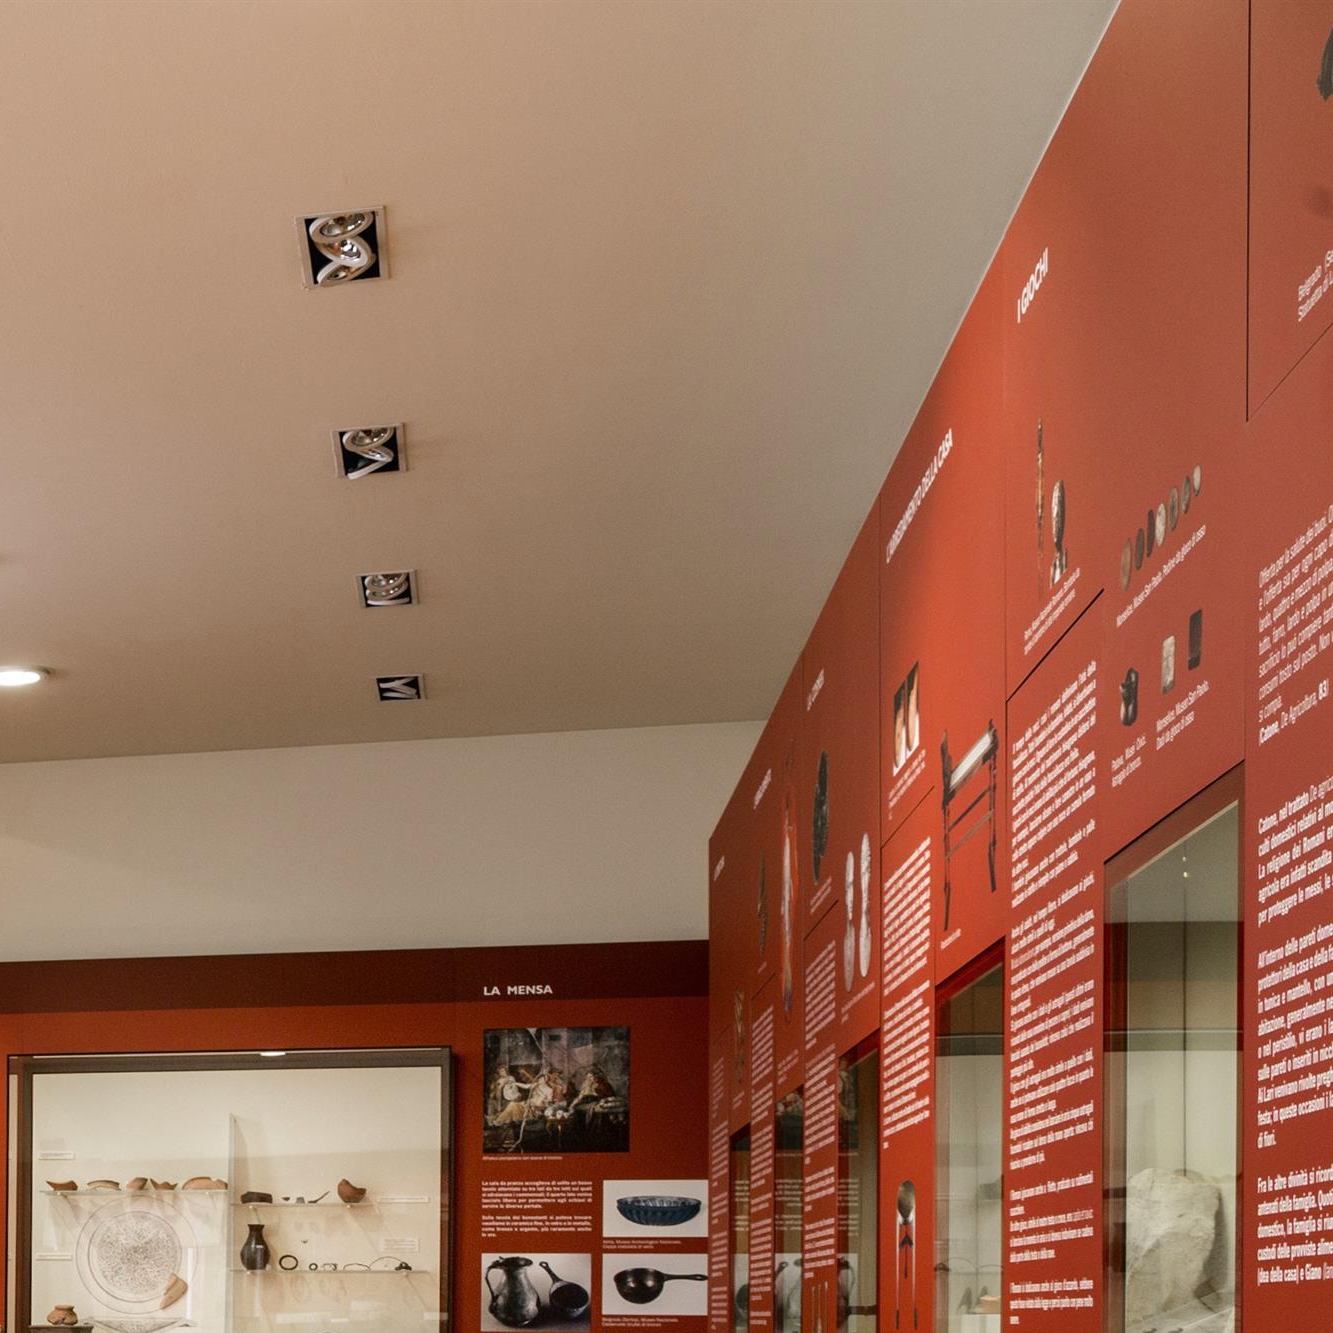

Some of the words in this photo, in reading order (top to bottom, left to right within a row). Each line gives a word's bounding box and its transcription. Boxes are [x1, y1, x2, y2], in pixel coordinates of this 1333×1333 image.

[1021, 247, 1049, 314] GIOCHI
[1258, 812, 1278, 834] Catone,
[1278, 801, 1288, 821] nel
[1287, 791, 1309, 816] trattato
[1309, 785, 1317, 802] De
[1258, 835, 1270, 857] culti
[1270, 819, 1296, 849] domestici
[1296, 807, 1317, 833] relativi
[1317, 803, 1324, 821] al
[1258, 863, 1265, 880] La
[1266, 850, 1290, 874] religione
[1291, 840, 1301, 860] dei
[1302, 827, 1325, 854] Romani
[1258, 877, 1279, 903] agricola
[1279, 874, 1290, 890] era
[1290, 860, 1307, 884] infatti
[1307, 850, 1332, 875] scandita
[483, 986, 501, 996] LA
[507, 984, 553, 995] MENSA
[1257, 1177, 1267, 1193] Fra
[1267, 1175, 1273, 1191] le
[1273, 1174, 1287, 1190] altre
[1287, 1169, 1308, 1188] divinità
[1308, 1168, 1315, 1184] si
